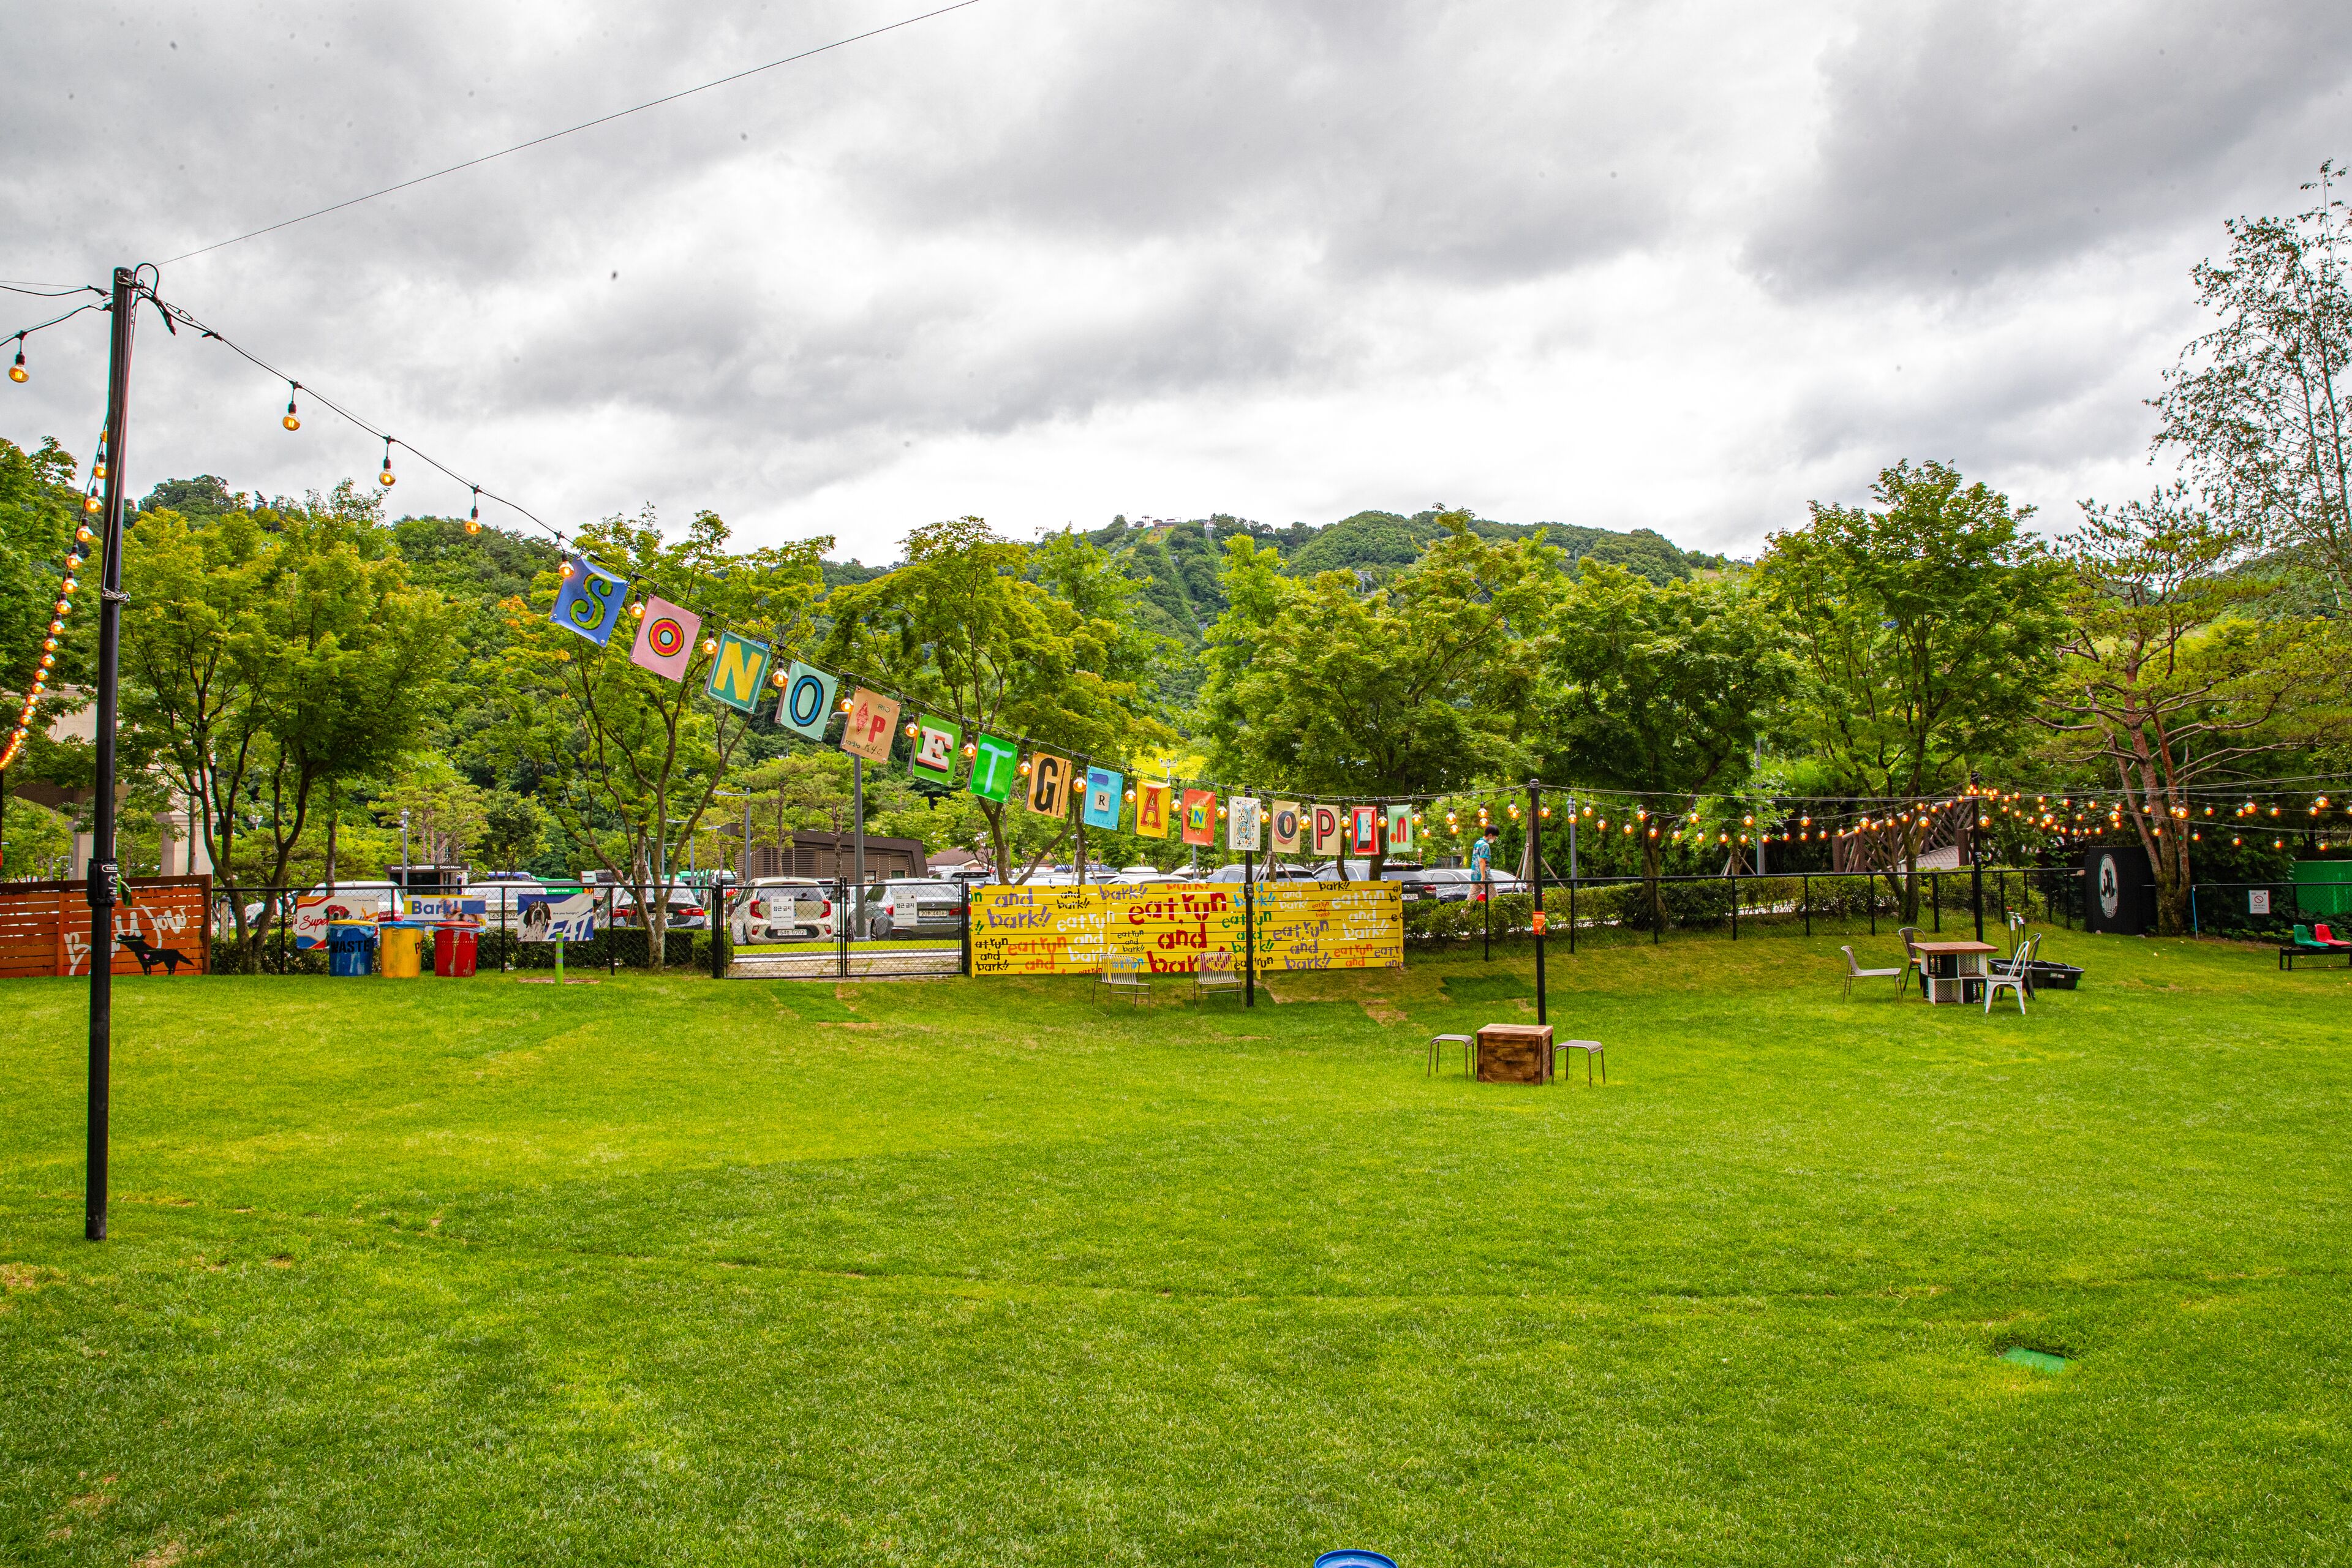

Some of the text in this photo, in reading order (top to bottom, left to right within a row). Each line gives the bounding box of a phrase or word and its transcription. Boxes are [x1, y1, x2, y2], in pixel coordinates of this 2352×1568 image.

[995, 888, 1034, 907] and
[987, 906, 1053, 929] bark!!
[1158, 922, 1207, 949] and
[1343, 919, 1390, 938] bark!!
[1074, 930, 1104, 946] and
[1290, 939, 1318, 954] and
[981, 950, 1000, 960] and
[1025, 954, 1055, 970] and
[1346, 956, 1365, 967] and
[976, 960, 1009, 971] bark!!
